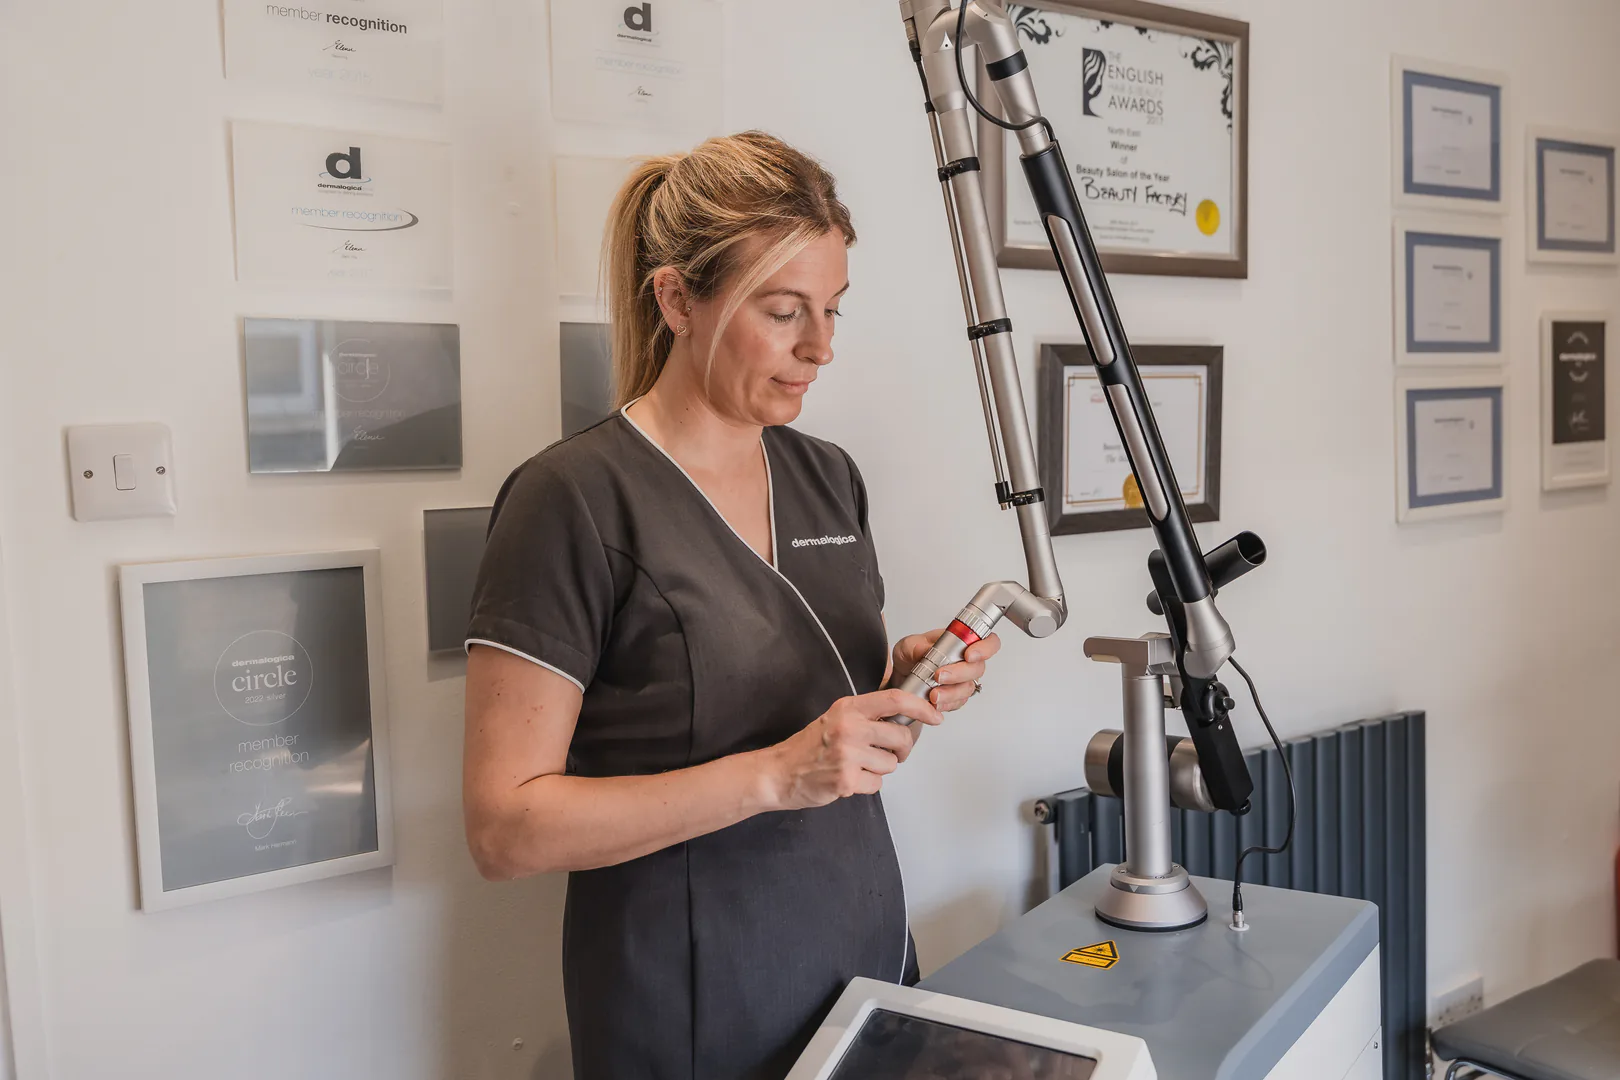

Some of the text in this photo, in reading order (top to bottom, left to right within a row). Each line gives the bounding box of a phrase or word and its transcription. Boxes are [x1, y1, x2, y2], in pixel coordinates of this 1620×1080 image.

[266, 4, 407, 34] member recognition
[623, 2, 652, 32] d
[1107, 64, 1163, 85] ENGLISH
[1107, 95, 1164, 116] AWARDS
[1110, 140, 1137, 151] Winner
[325, 146, 362, 179] d
[1076, 164, 1170, 182] Beauty Salon of the Year
[317, 183, 362, 191] dermalogica
[291, 206, 403, 222] member recognition
[792, 535, 857, 548] dermalogica
[232, 655, 295, 667] dermalogica
[232, 664, 297, 692] circle
[245, 692, 286, 704] 2022 silver
[238, 734, 300, 753] member
[229, 751, 310, 773] recognition
